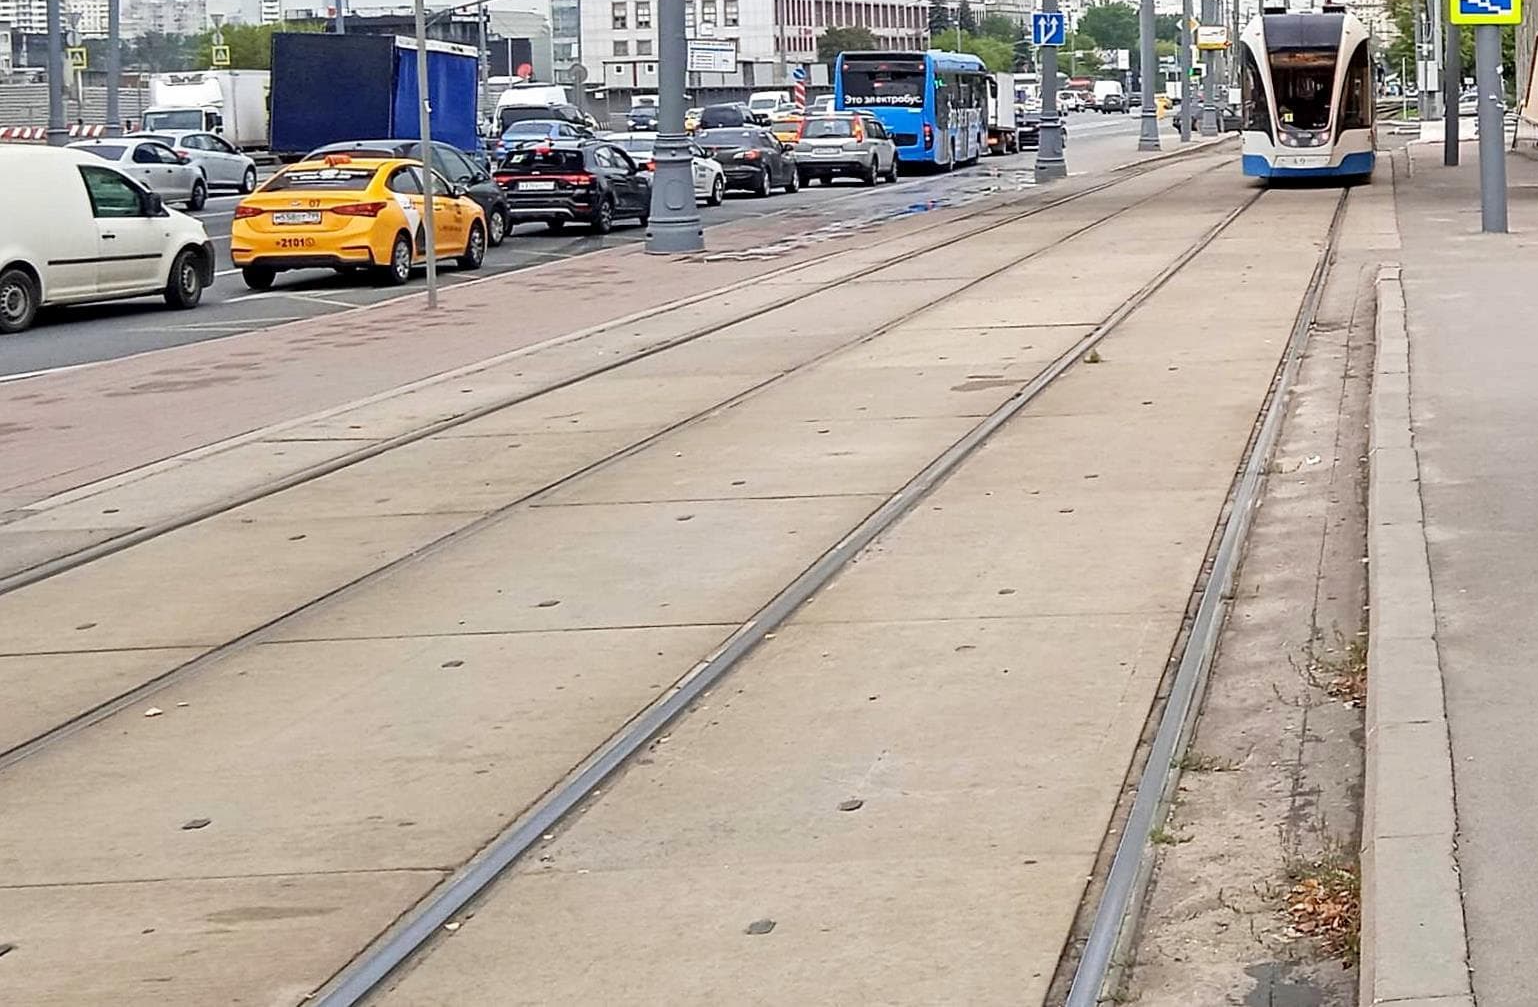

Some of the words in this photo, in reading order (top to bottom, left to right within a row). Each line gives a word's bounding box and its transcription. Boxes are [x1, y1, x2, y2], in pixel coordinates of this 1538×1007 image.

[844, 95, 862, 104] Это
[864, 94, 922, 105] электробус.
[309, 199, 321, 207] 07
